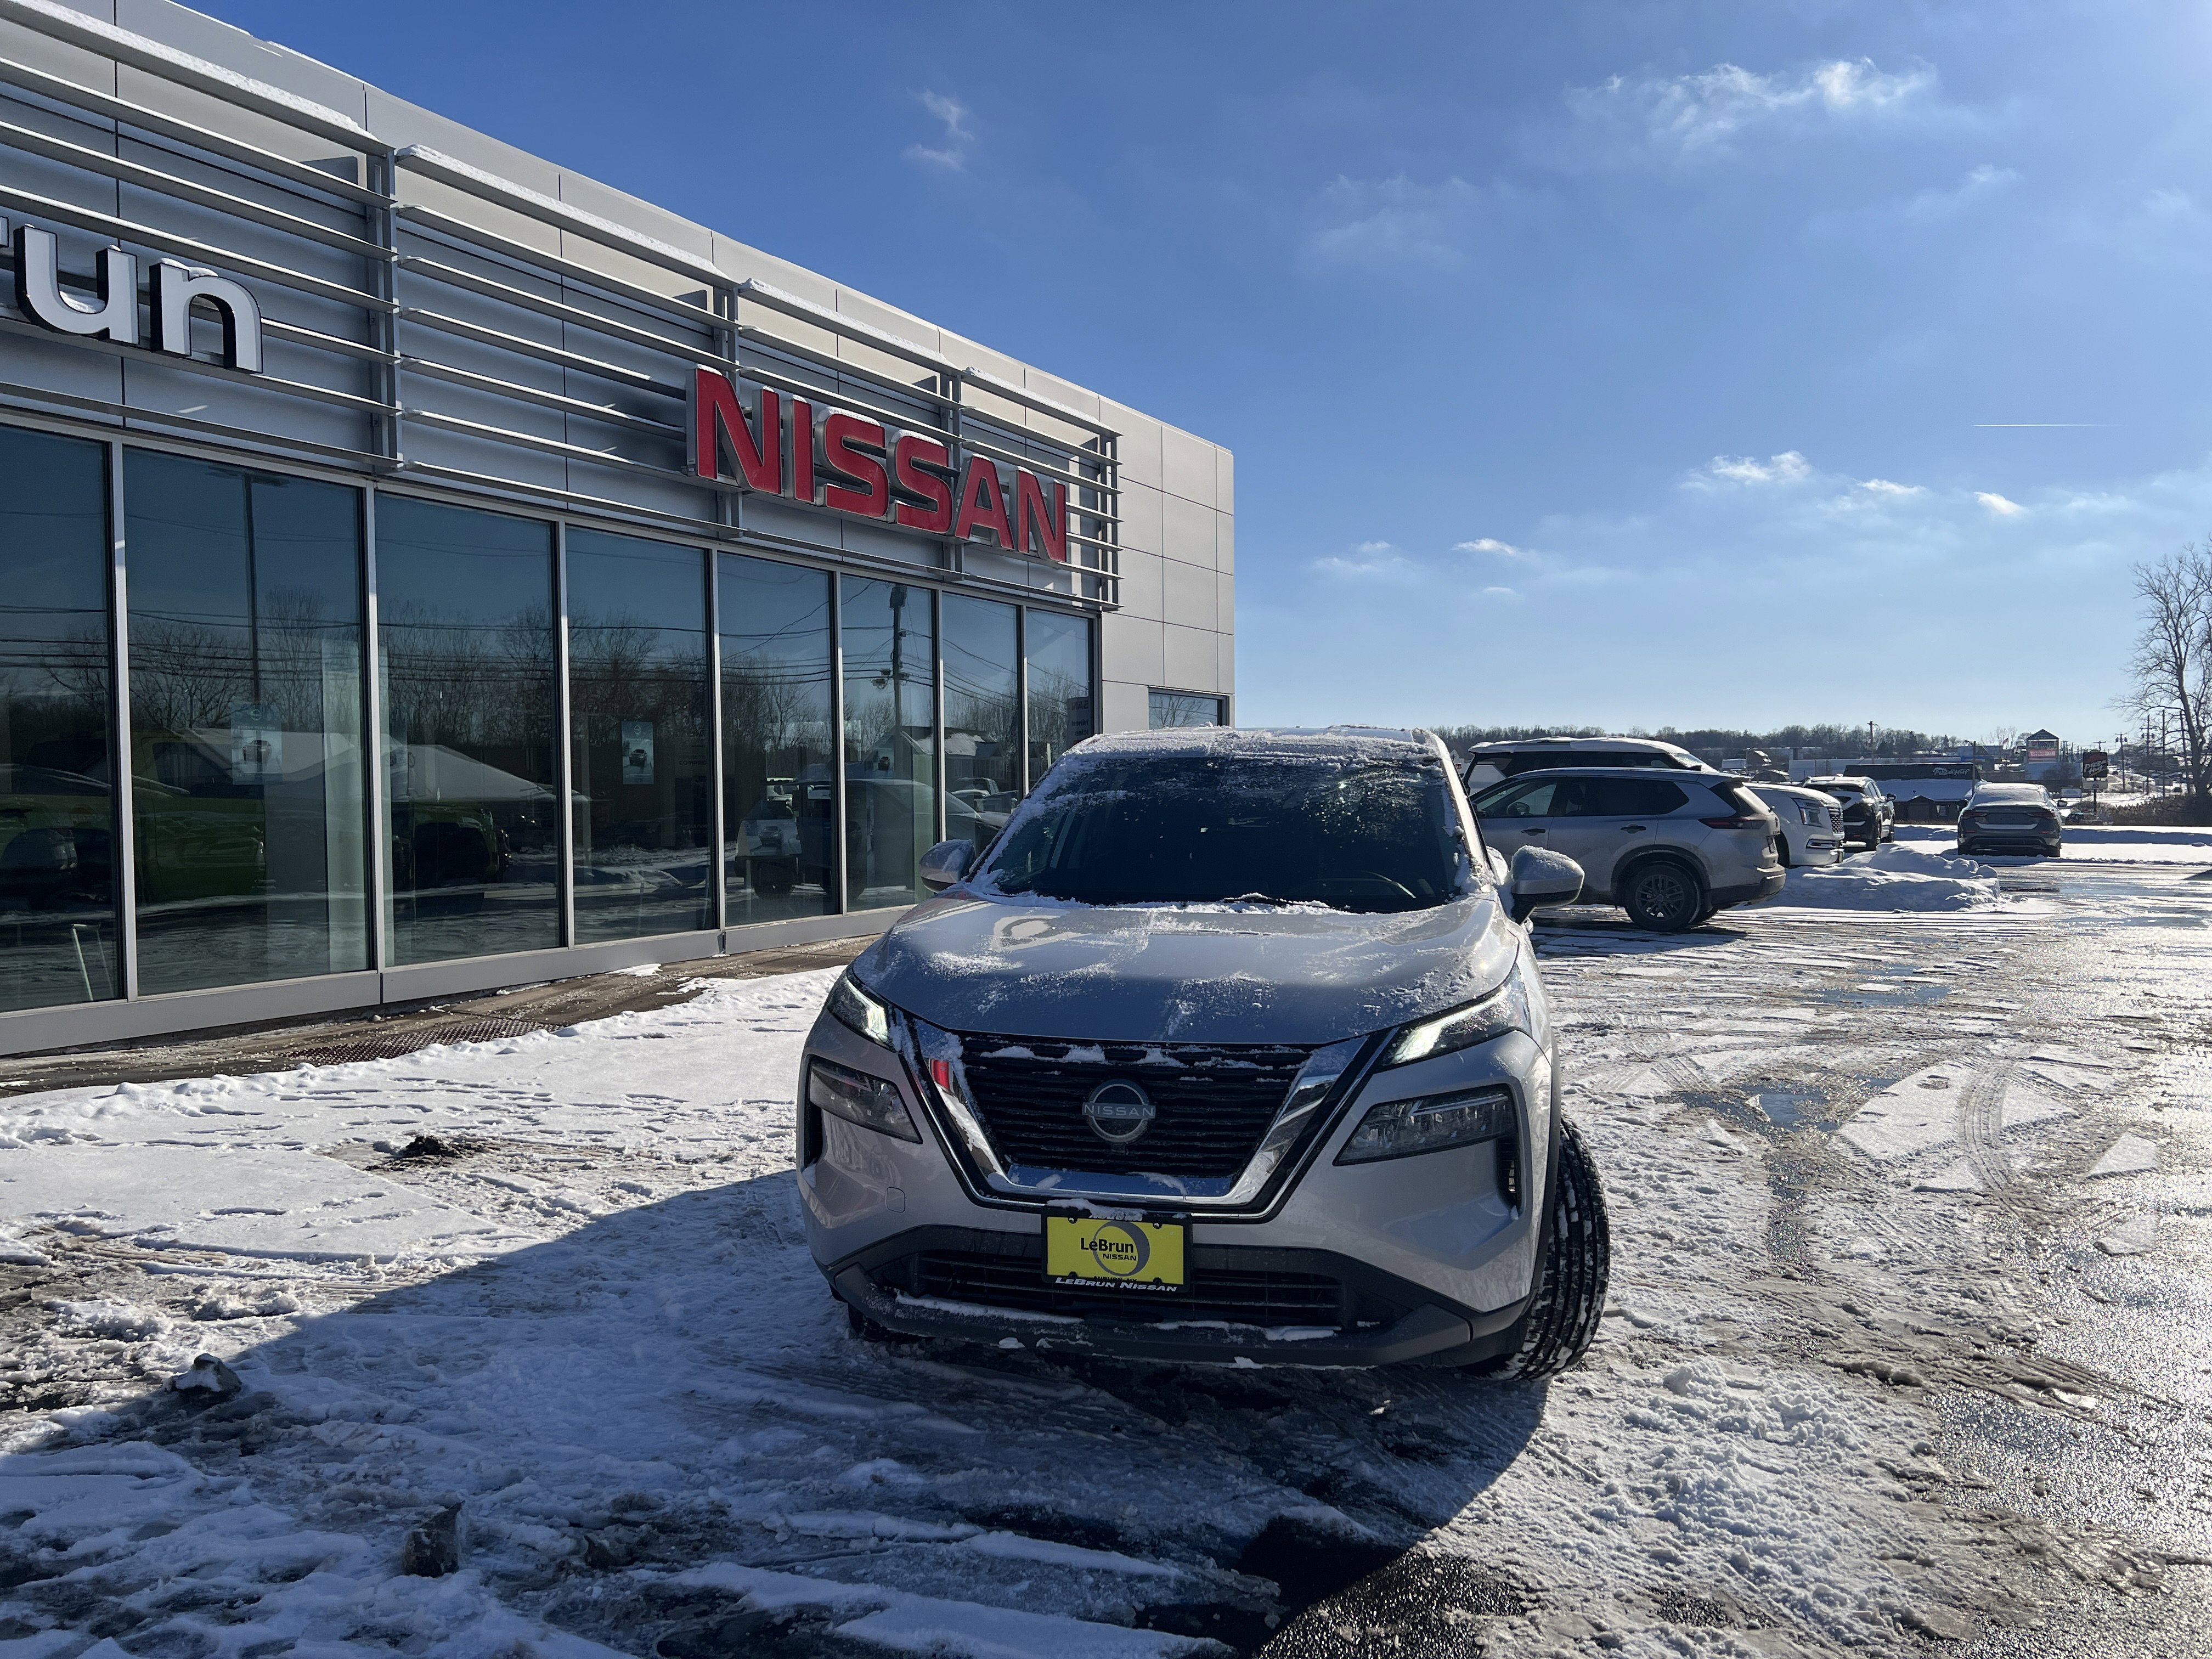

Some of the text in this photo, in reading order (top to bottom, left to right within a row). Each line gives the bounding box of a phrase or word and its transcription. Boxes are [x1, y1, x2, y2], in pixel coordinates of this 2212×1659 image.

[0, 217, 263, 374] un
[686, 364, 1067, 563] NISSAN
[2084, 760, 2107, 773] Pizza
[2088, 765, 2104, 775] Hut
[1084, 1104, 1153, 1116] NISSAN
[1080, 1238, 1134, 1253] LeBrun
[1120, 1282, 1177, 1292] NISSAN
